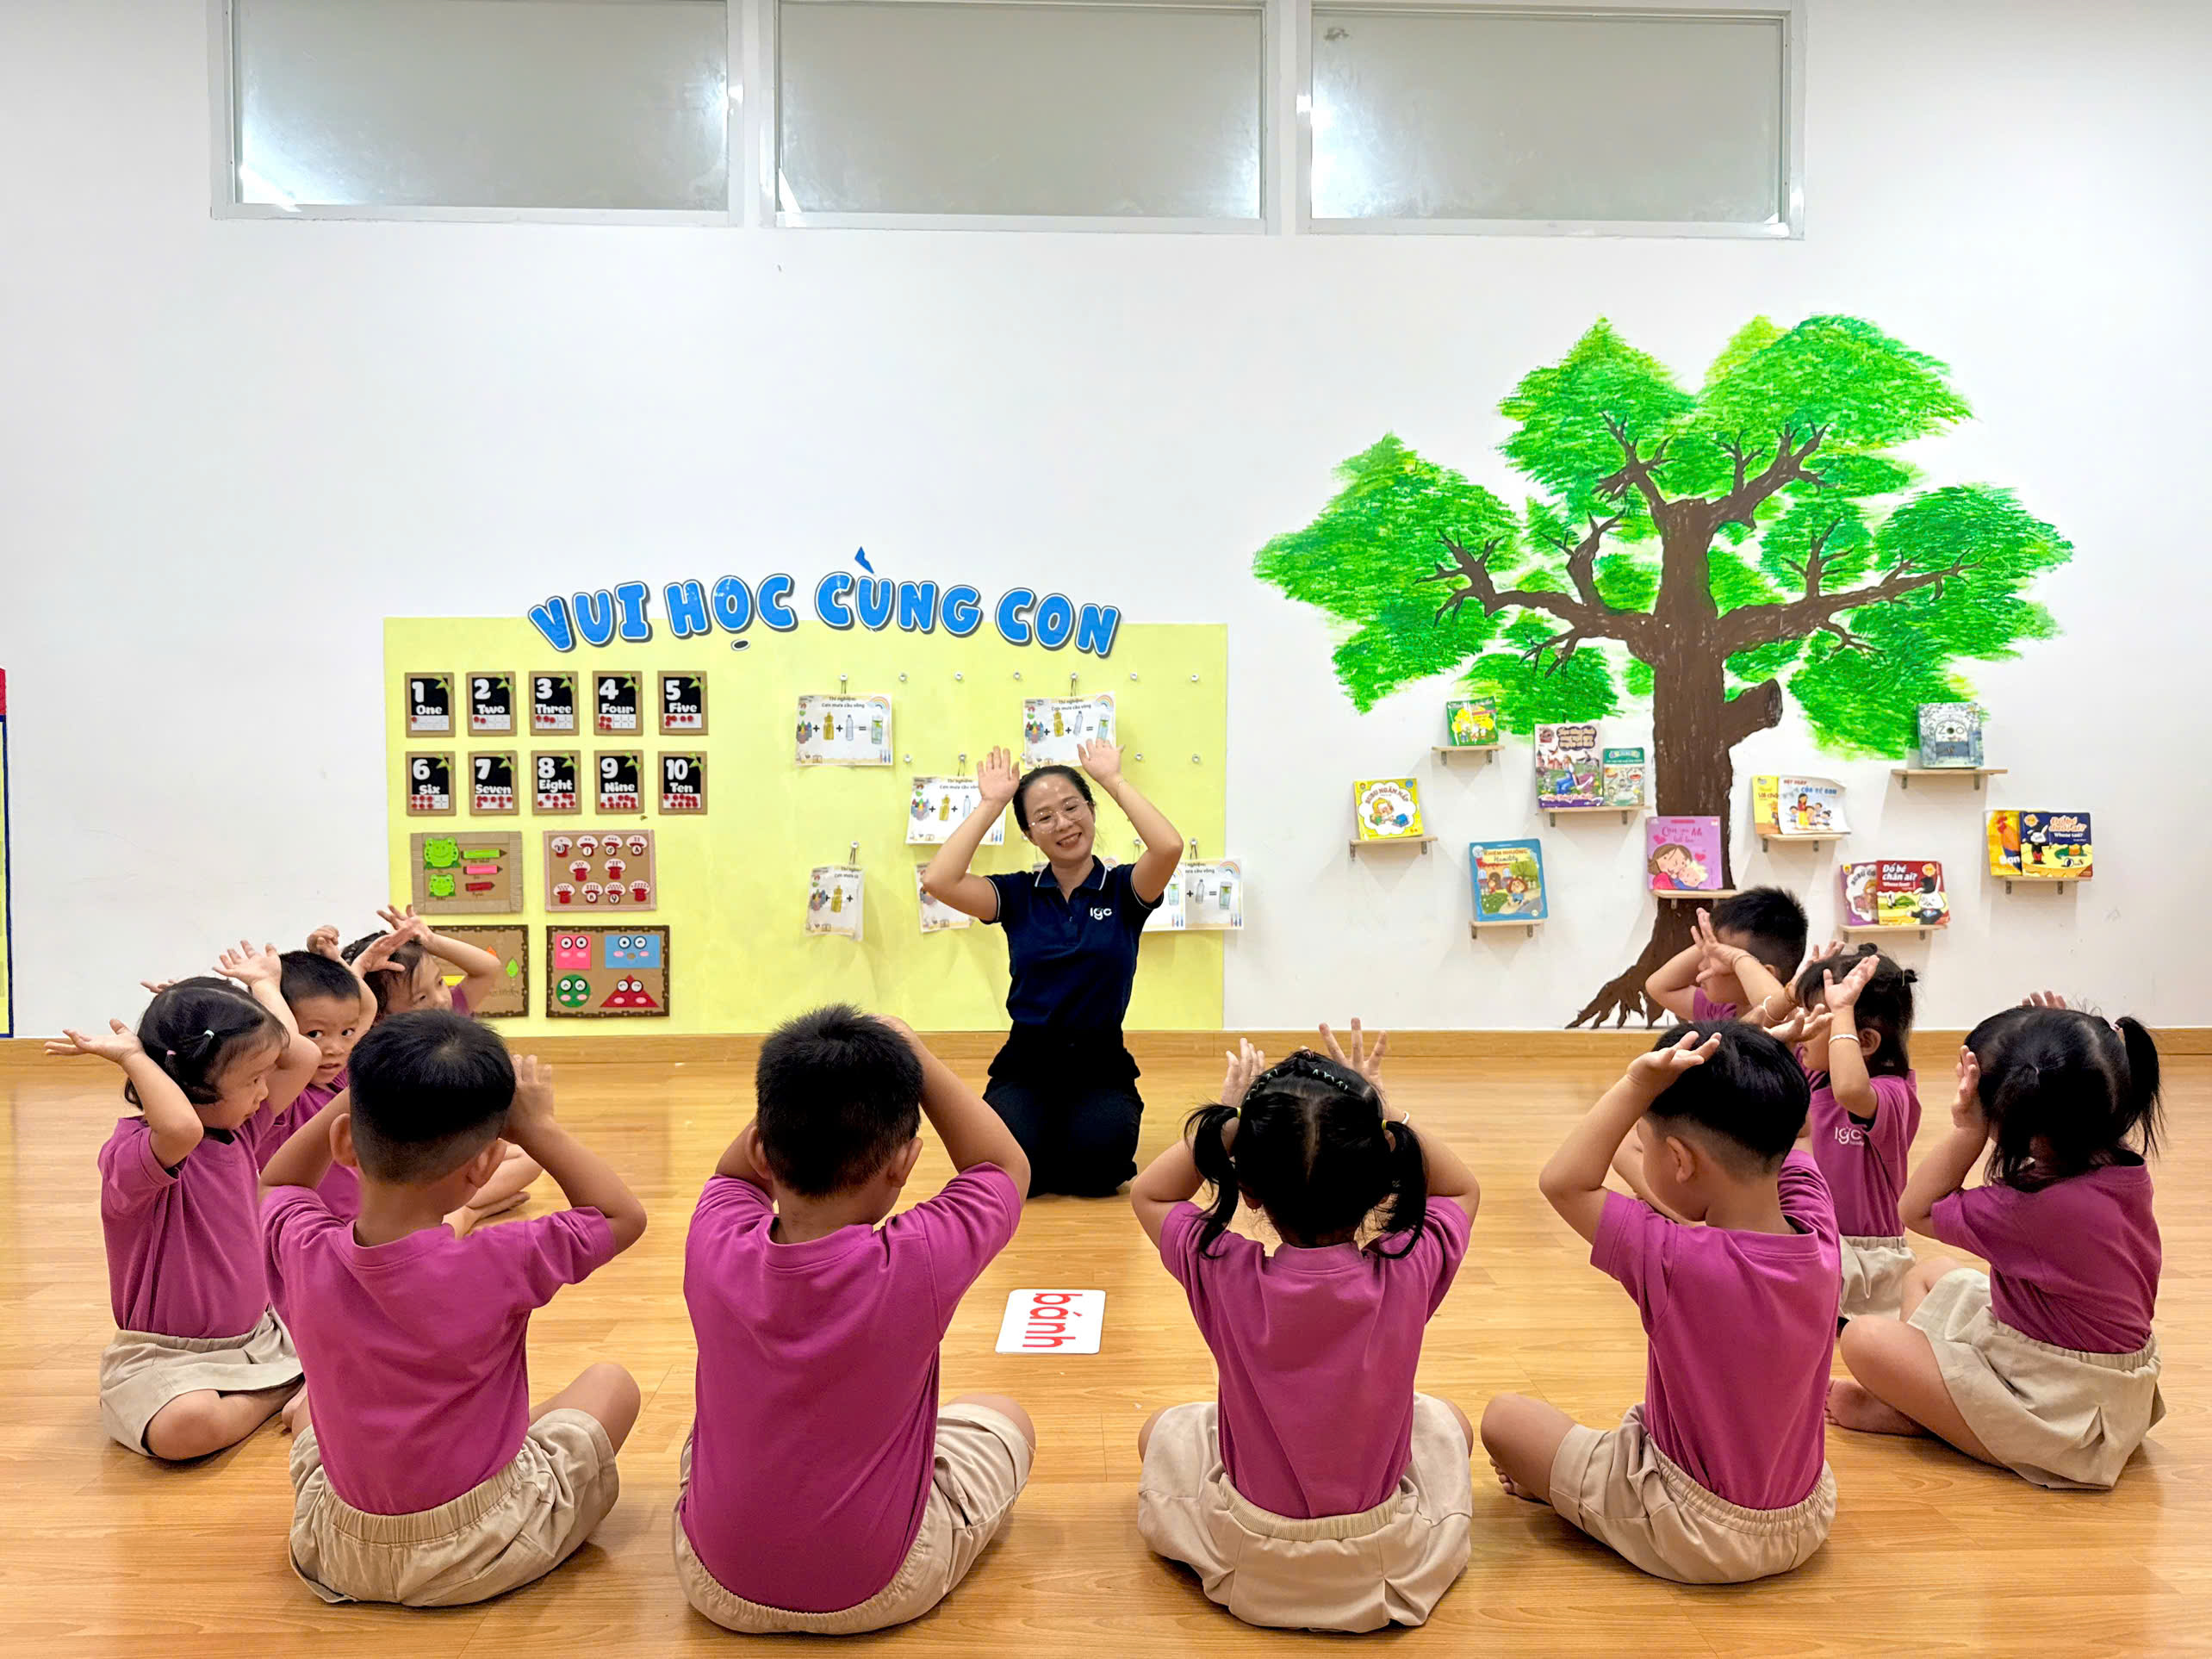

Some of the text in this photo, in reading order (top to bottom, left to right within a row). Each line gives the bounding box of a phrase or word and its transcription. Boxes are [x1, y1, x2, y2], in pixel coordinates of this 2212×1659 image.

[526, 546, 1122, 658] VUI HỌC CÙNG CON
[412, 680, 425, 703] 1
[474, 678, 492, 699] 2
[536, 678, 553, 699] 3
[599, 679, 619, 700] 4
[665, 680, 681, 700] 5
[416, 705, 443, 715] One
[476, 704, 505, 714] Two
[535, 704, 572, 714] Three
[601, 703, 634, 714] Four
[668, 702, 697, 713] Five
[413, 758, 431, 780] 6
[475, 758, 492, 780] 7
[537, 757, 556, 779] 8
[600, 757, 618, 779] 9
[665, 759, 688, 780] 10
[419, 784, 440, 795] Six
[475, 784, 512, 794] Seven
[538, 780, 573, 793] Eight
[604, 782, 635, 792] Nine
[669, 782, 693, 792] Ten
[1882, 862, 1906, 873] Đố bé
[1022, 1293, 1083, 1347] bánh
